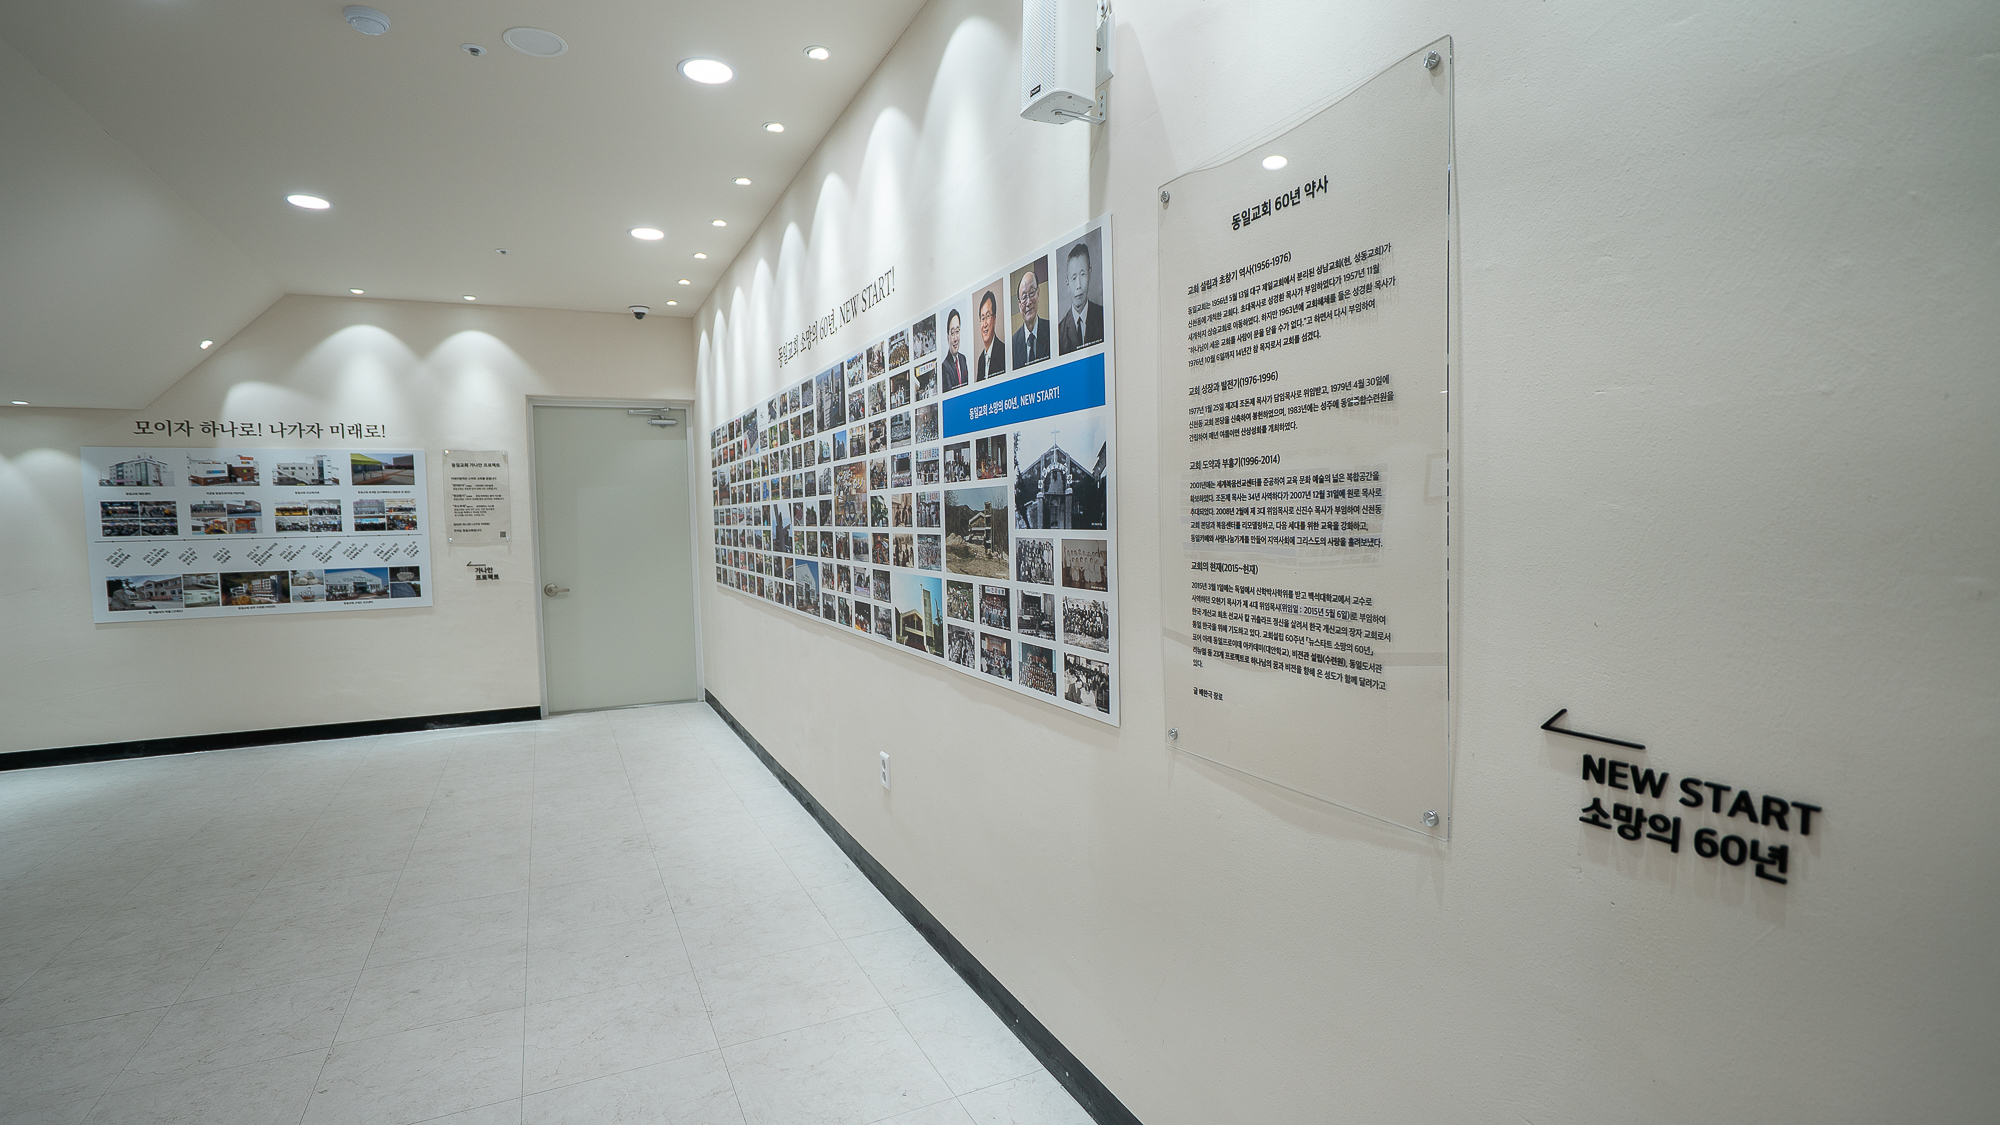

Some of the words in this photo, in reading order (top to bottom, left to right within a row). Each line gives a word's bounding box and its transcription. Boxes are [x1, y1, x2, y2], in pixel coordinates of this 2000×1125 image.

[1231, 199, 1270, 230] 동일교회
[1275, 186, 1300, 210] 60년
[1304, 175, 1328, 198] 약사
[1187, 283, 1198, 294] 교회
[1200, 276, 1217, 291] 설립과
[1219, 269, 1237, 284] 초창기
[1238, 251, 1291, 277] 역사(1956-1976)
[1250, 285, 1260, 294] 대구
[1262, 273, 1294, 291] 제일교회에서
[1296, 267, 1314, 280] 분리된
[1316, 255, 1351, 274] 성남교회(현,
[1354, 242, 1391, 262] 성동교회)가
[1240, 298, 1266, 312] 초대목사로
[1285, 286, 1303, 299] 목사가
[1304, 275, 1341, 294] 부임하였다가
[1343, 267, 1364, 281] 1957년
[1366, 263, 1379, 274] 11월
[1338, 289, 1350, 300] 들은
[1374, 275, 1395, 289] 목사가
[778, 335, 798, 368] 동일교회
[801, 321, 818, 352] 소망의
[819, 308, 837, 340] 60년,
[839, 293, 859, 328] NEW
[861, 266, 895, 312] START!
[1253, 328, 1264, 338] 문을
[1265, 325, 1276, 335] 닫을
[1277, 321, 1289, 332] 수가
[1313, 310, 1332, 322] 하면서
[1334, 306, 1346, 317] 다시
[1348, 298, 1374, 313] 부임하여
[1259, 338, 1281, 351] 목자로서
[1282, 334, 1299, 345] 교회를
[1301, 329, 1320, 342] 섬겼다.
[1188, 385, 1200, 395] 교회
[1201, 381, 1219, 394] 성장과
[1220, 370, 1278, 390] 발전기(1976-1996)
[1256, 394, 1272, 404] 목사가
[1273, 390, 1302, 402] 담임목사로
[1330, 380, 1351, 392] 1979년
[1353, 378, 1364, 388] 4월
[1366, 374, 1388, 386] 30일에
[969, 404, 988, 420] 동일교회
[988, 399, 1003, 415] 소망의
[1004, 396, 1019, 410] 60년,
[1020, 392, 1036, 406] NEW
[1036, 386, 1060, 403] START!
[133, 420, 194, 438] 모이자
[199, 420, 262, 438] 하나로!
[268, 422, 323, 439] 나가자
[329, 423, 385, 439] 미래로!
[1189, 460, 1201, 470] 교회
[1202, 458, 1220, 468] 도약과
[1222, 454, 1280, 468] 부흥기(1996-2014)
[1299, 474, 1310, 484] 문화
[1312, 474, 1330, 483] 예술의
[1332, 473, 1344, 482] 넓은
[1346, 470, 1379, 481] 복합공간을
[1290, 490, 1310, 499] 2007년
[1312, 490, 1324, 499] 12월
[1326, 489, 1345, 498] 31일에
[1346, 488, 1360, 498] 원로
[1361, 488, 1381, 497] 목사로
[1266, 506, 1294, 514] 위임목사로
[1314, 505, 1332, 514] 목사가
[1334, 504, 1359, 514] 부임하여
[1361, 504, 1382, 514] 신천동
[1242, 521, 1274, 529] 리모델링하고,
[1276, 521, 1287, 529] 다음
[1288, 521, 1305, 530] 세대를
[1307, 521, 1319, 530] 위한
[1320, 521, 1338, 530] 교육을
[1340, 521, 1368, 530] 강화하고,
[1296, 536, 1326, 546] 그리스도의
[1327, 537, 1346, 546] 사랑을
[1347, 537, 1382, 547] 흘려보냈다.
[1191, 561, 1208, 571] 교회의
[1209, 562, 1258, 574] 현재(2015~현재)
[1294, 590, 1306, 599] 받고
[1308, 592, 1350, 604] 백석대학교에서
[1352, 596, 1372, 605] 교수로
[1304, 606, 1323, 617] 2015년
[1325, 608, 1335, 619] 5월
[1336, 610, 1357, 621] 6일)로
[1359, 613, 1385, 624] 부임하여
[1249, 628, 1261, 637] 있다.
[1262, 630, 1283, 641] 교회설립
[1285, 634, 1304, 644] 60주년
[1334, 642, 1352, 652] 소망의
[1272, 617, 1289, 627] 정신을
[1290, 620, 1307, 630] 살려서
[1309, 622, 1321, 632] 한국
[1322, 624, 1347, 636] 개신교의
[1348, 627, 1362, 638] 장자
[1363, 630, 1390, 642] 교회로서
[1310, 653, 1347, 667] 설립(수련원),
[1349, 659, 1382, 673] 동일도서관
[1284, 663, 1301, 674] 비전을
[1303, 666, 1314, 676] 향해
[1324, 670, 1342, 682] 성도가
[1344, 674, 1357, 684] 함께
[1359, 677, 1385, 690] 달려가고
[1581, 753, 1670, 799] NEW
[1678, 776, 1822, 836] START
[1579, 797, 1681, 853] 소망의
[1693, 827, 1789, 885] 60년
